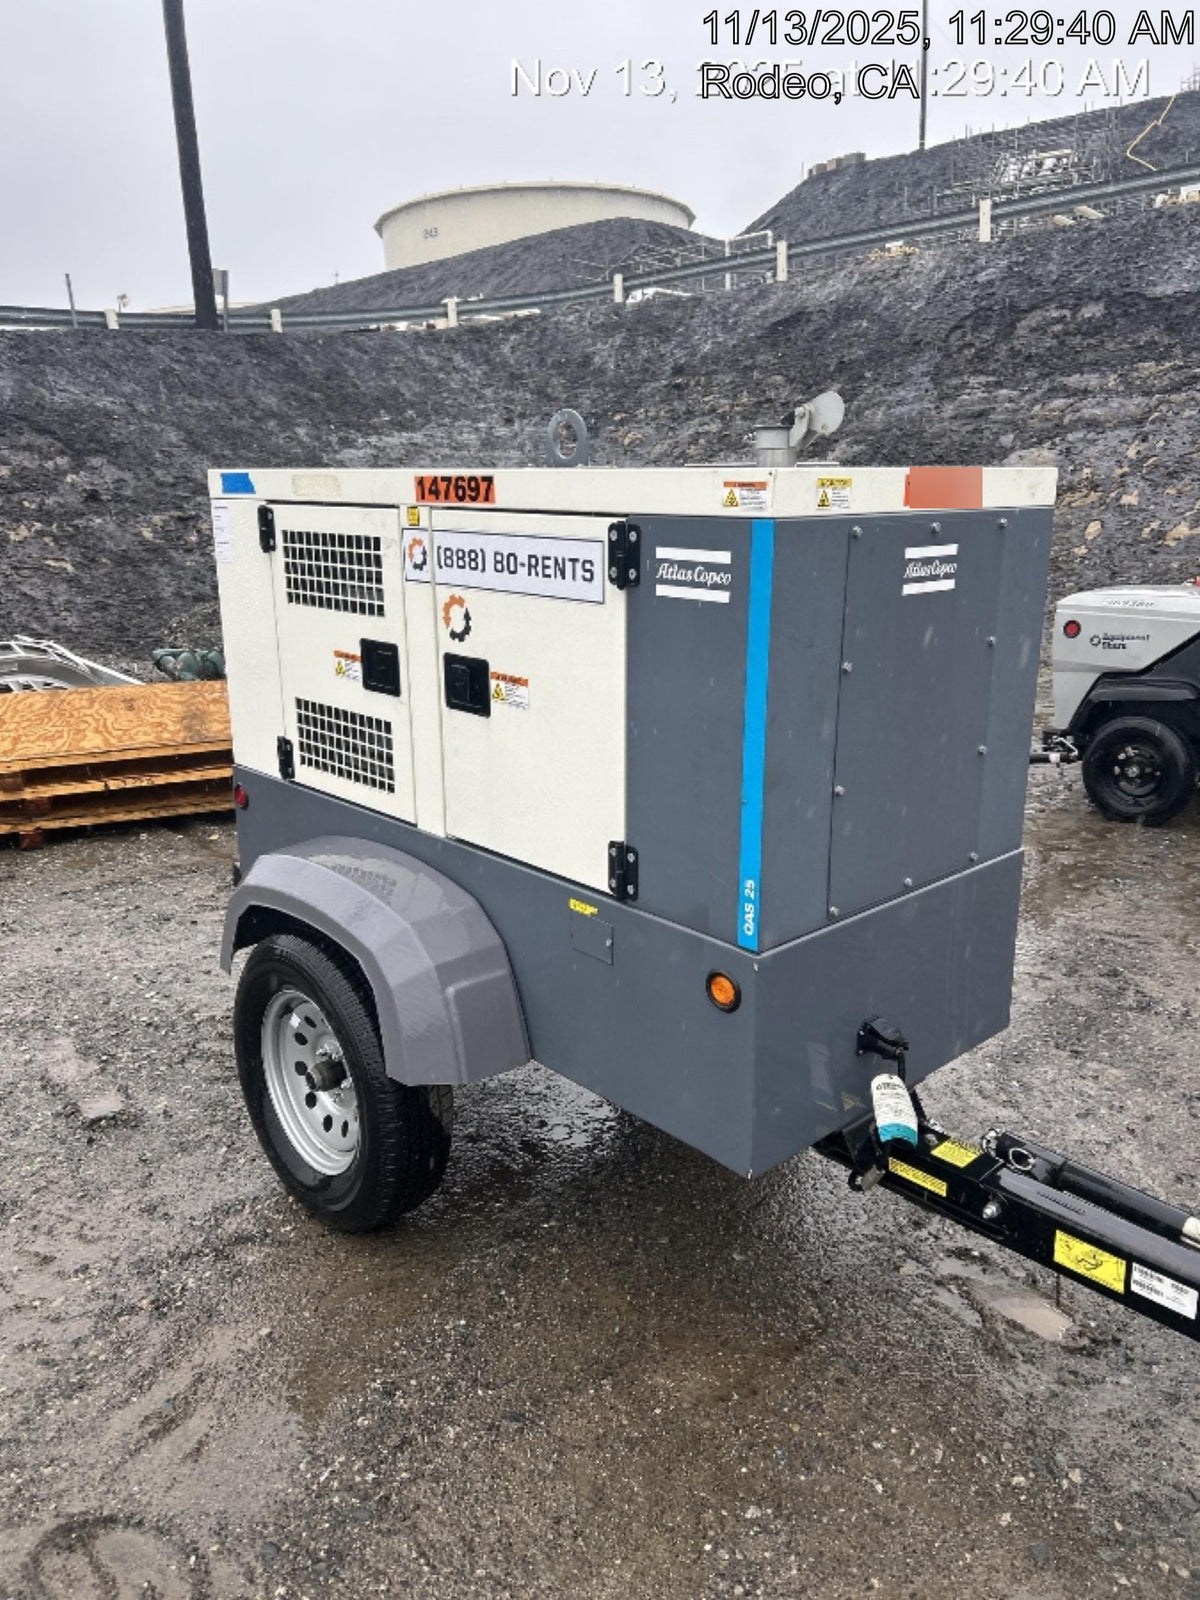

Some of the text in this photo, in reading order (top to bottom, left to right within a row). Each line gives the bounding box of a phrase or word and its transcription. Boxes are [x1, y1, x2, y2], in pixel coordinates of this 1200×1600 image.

[416, 475, 494, 502] 147697
[437, 545, 595, 584] (888) 80-RENTS
[656, 562, 732, 588] Atlas Copco
[744, 879, 756, 901] 25
